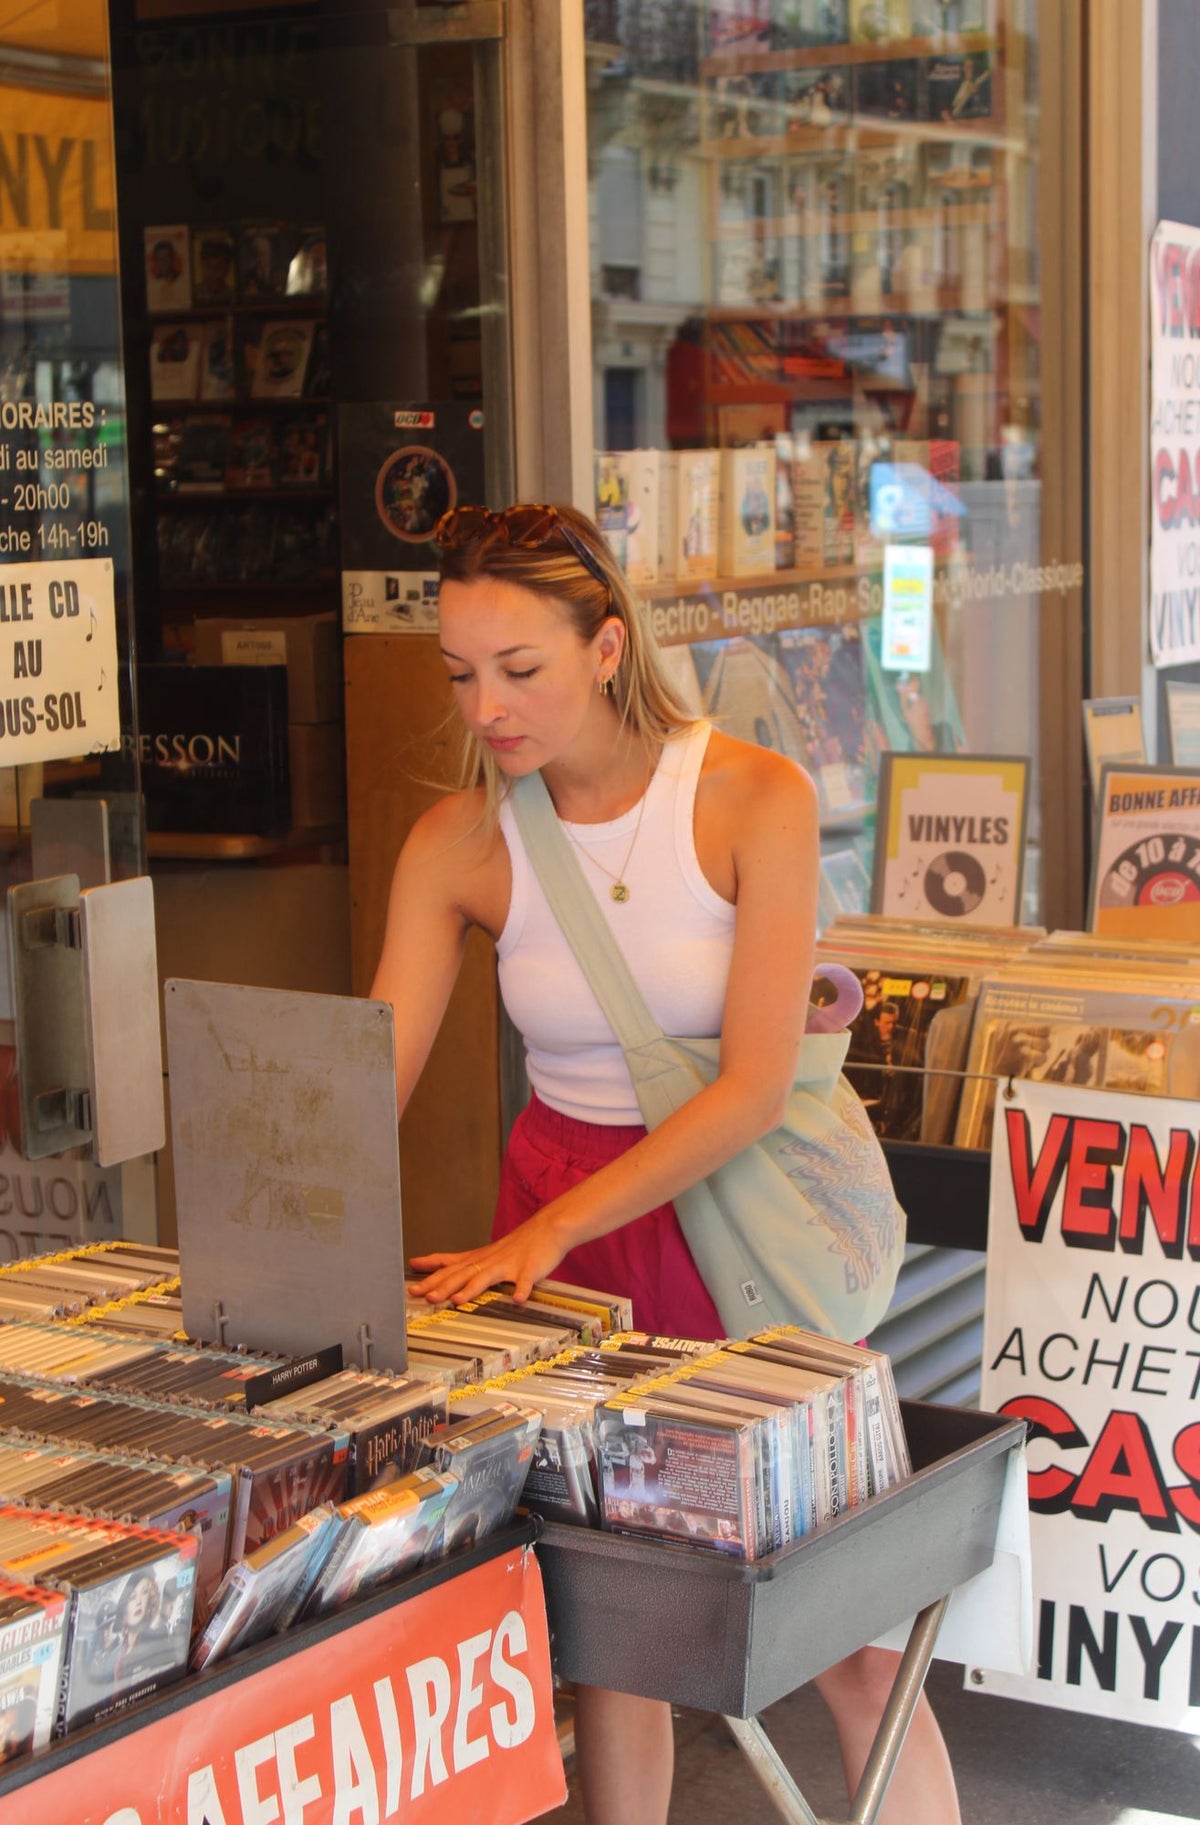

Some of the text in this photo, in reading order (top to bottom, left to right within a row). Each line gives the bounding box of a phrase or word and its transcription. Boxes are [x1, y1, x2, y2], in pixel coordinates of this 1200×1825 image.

[1154, 242, 1200, 338] VEN
[1171, 352, 1200, 388] NO
[0, 402, 95, 429] ORAIRES
[1151, 398, 1200, 436] ACHE
[16, 449, 38, 470] au
[44, 442, 108, 469] samedi
[14, 483, 70, 511] 20h00
[1154, 446, 1200, 531] CA
[38, 521, 108, 549] 14h-19h
[49, 580, 80, 619] CD
[1155, 586, 1200, 650] VINY
[14, 639, 42, 679] AU
[1109, 787, 1200, 813] BONNE AFF
[908, 814, 1009, 845] VINYLES
[1004, 1107, 1200, 1262] VEN
[272, 1358, 319, 1385] HARRY POTTER
[1099, 1544, 1200, 1603] VO
[1037, 1599, 1200, 1707] INY
[186, 1610, 536, 1825] AFFAIRES
